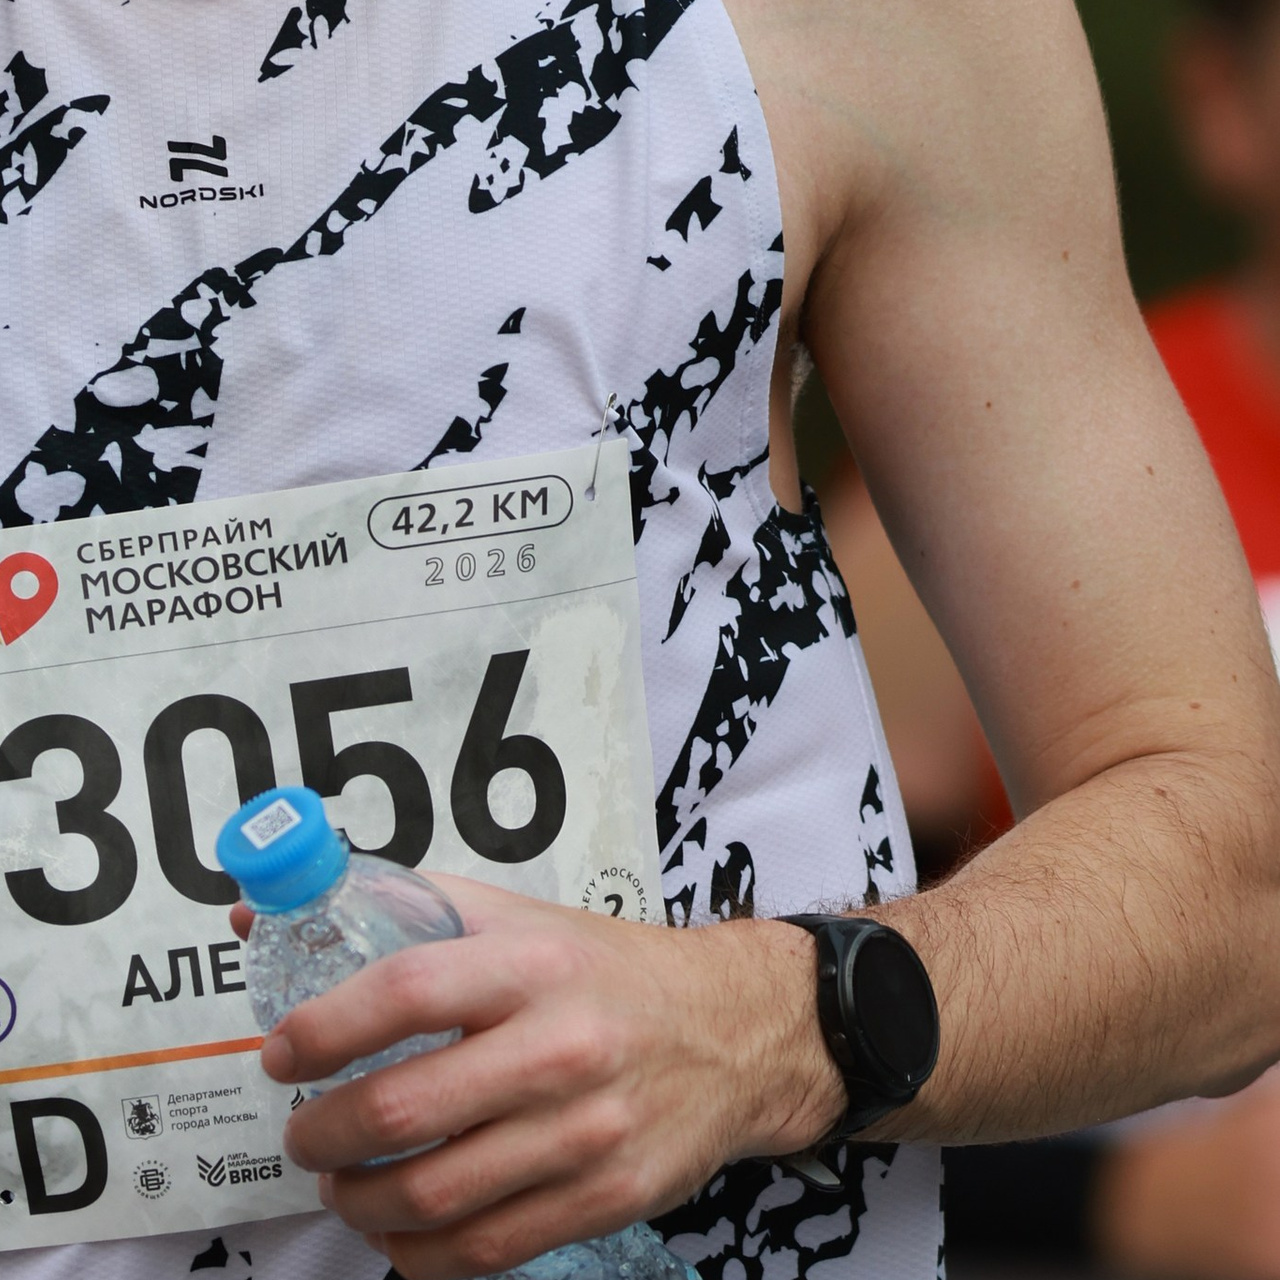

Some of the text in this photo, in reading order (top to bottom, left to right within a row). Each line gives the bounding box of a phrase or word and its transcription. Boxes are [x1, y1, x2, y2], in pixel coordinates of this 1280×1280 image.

[139, 183, 264, 209] NORDSKI
[392, 496, 475, 536] 42,2
[76, 517, 273, 564] СБЕРПРАЙМ
[80, 536, 349, 600] МОСКОВСКИЙ
[424, 543, 537, 586] 2026
[85, 581, 283, 634] МАРАФОН
[121, 940, 247, 1007] АЛЕ
[167, 1086, 243, 1105] Департамент
[169, 1104, 208, 1118] спорта
[171, 1111, 258, 1132] города Москвы
[9, 1097, 109, 1216] D
[226, 1152, 248, 1162] ЛИГА
[227, 1154, 282, 1169] МАРАФОНОВ
[229, 1163, 283, 1185] BRICS
